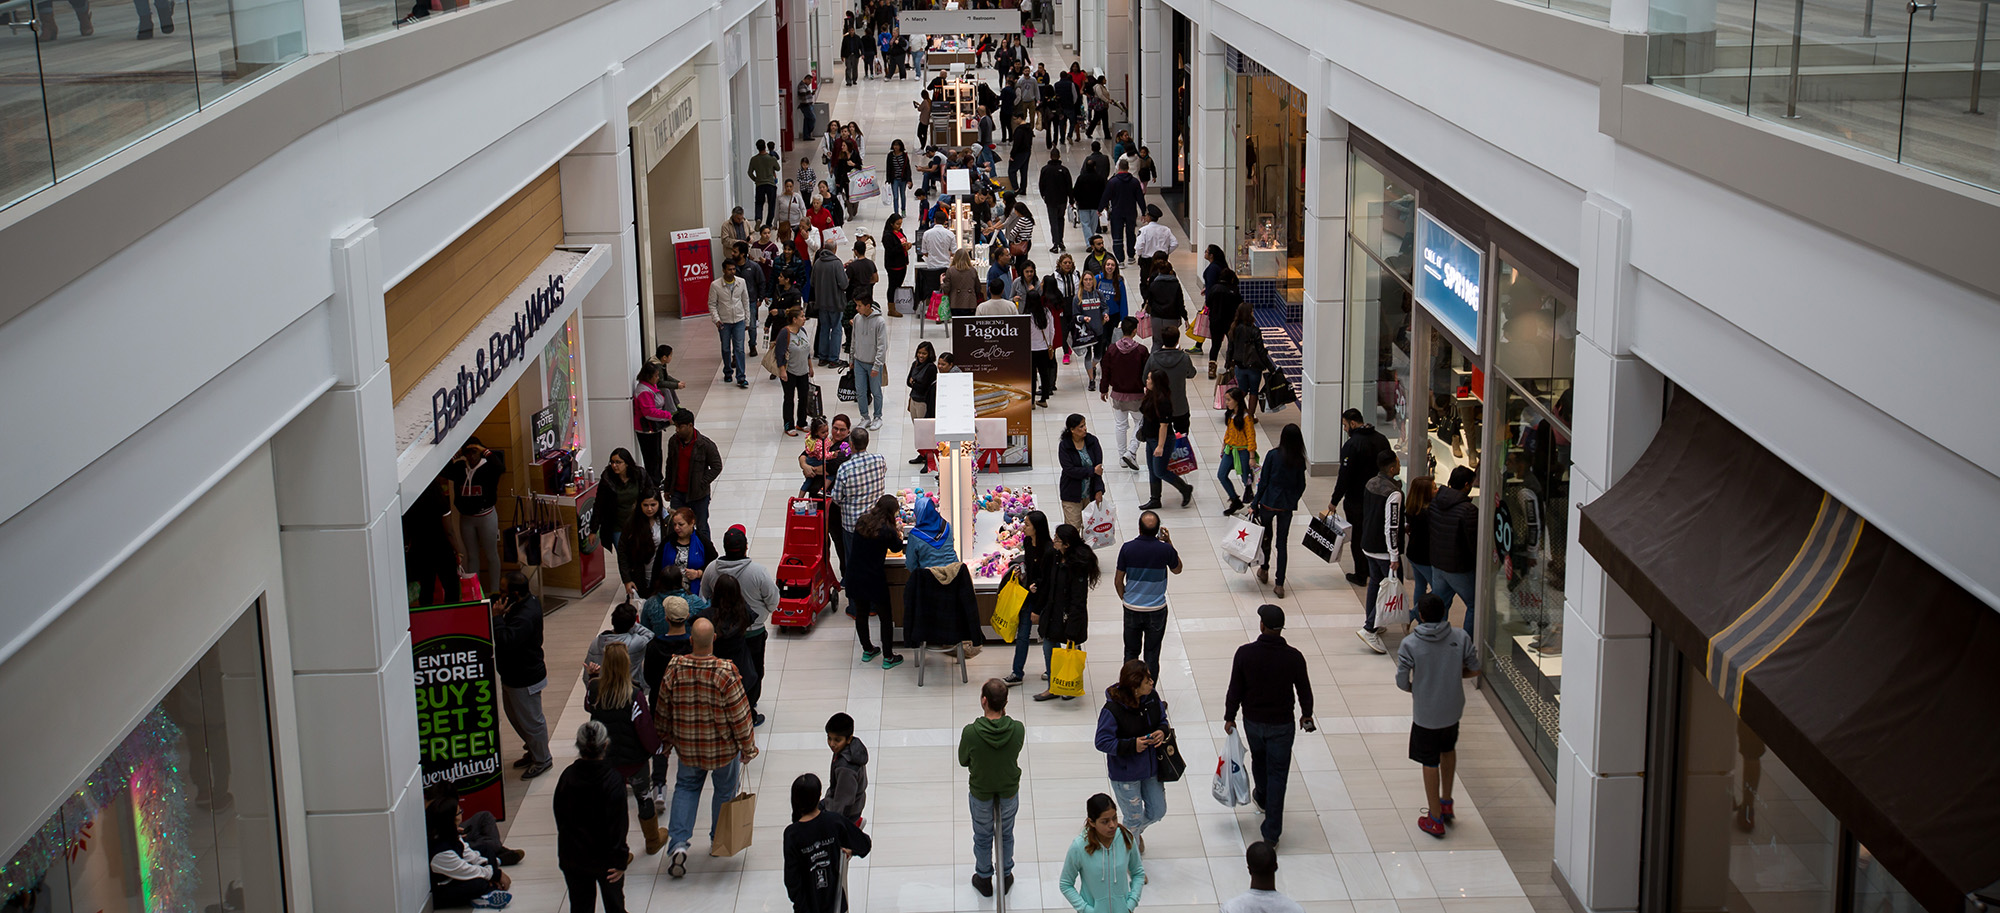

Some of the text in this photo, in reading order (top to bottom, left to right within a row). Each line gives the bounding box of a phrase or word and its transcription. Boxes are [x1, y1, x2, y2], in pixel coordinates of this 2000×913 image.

[653, 96, 693, 150] THE LIMITED
[676, 232, 689, 240] $12
[1443, 262, 1479, 312] SPRING
[964, 323, 1019, 340] Pagoda
[430, 364, 476, 445] Bath
[476, 348, 491, 396] &
[489, 311, 526, 382] Body
[525, 274, 565, 338] Works
[536, 429, 555, 452] $30
[1306, 526, 1334, 552] EXPRESS
[818, 582, 825, 605] 5
[1385, 593, 1403, 613] H&M
[418, 650, 478, 669] ENTIRE
[413, 663, 484, 686] STORE!
[415, 680, 491, 711] BUY 3
[417, 705, 493, 736] GET 3
[422, 752, 500, 788] verything!
